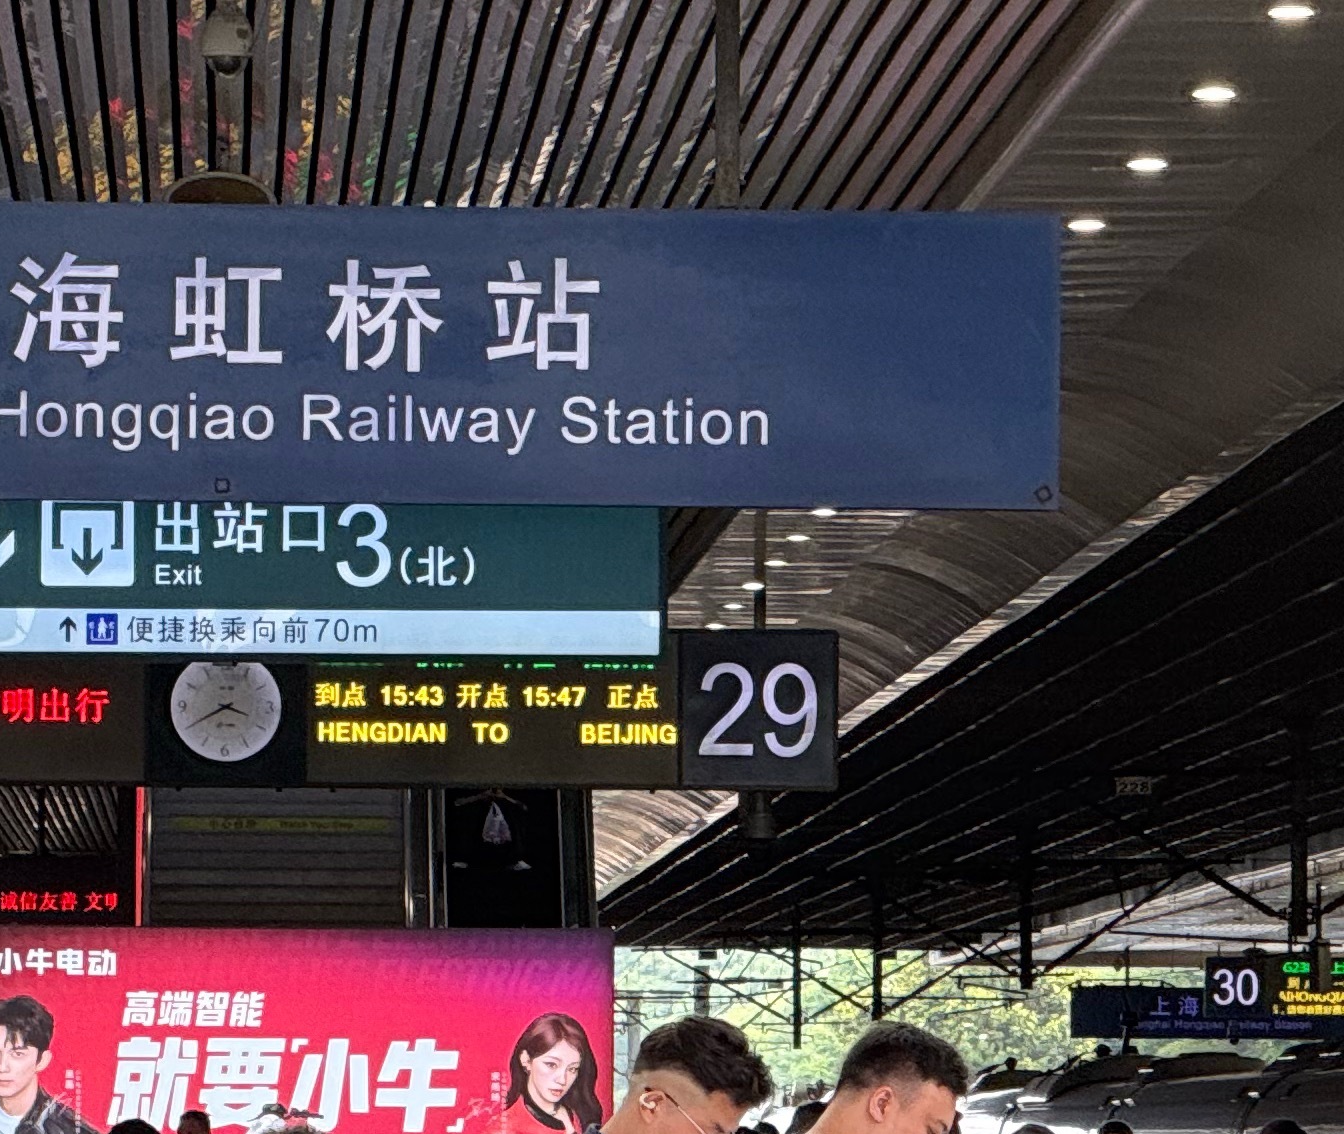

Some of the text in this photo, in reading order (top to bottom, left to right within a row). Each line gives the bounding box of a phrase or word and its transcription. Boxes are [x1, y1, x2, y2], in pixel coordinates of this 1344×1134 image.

[302, 393, 537, 455] Railway
[561, 395, 771, 447] Station
[154, 563, 203, 587] Exit
[126, 615, 379, 645] 便捷换乘向前70m
[315, 682, 660, 710] 到点 15:43 开点 15:47 正点
[698, 662, 818, 757] 29
[317, 722, 677, 746] HENGDIAN TO BEIJING
[0, 891, 78, 912] 诚信友善
[1213, 968, 1259, 1006] 30
[121, 991, 266, 1028] 高端智能
